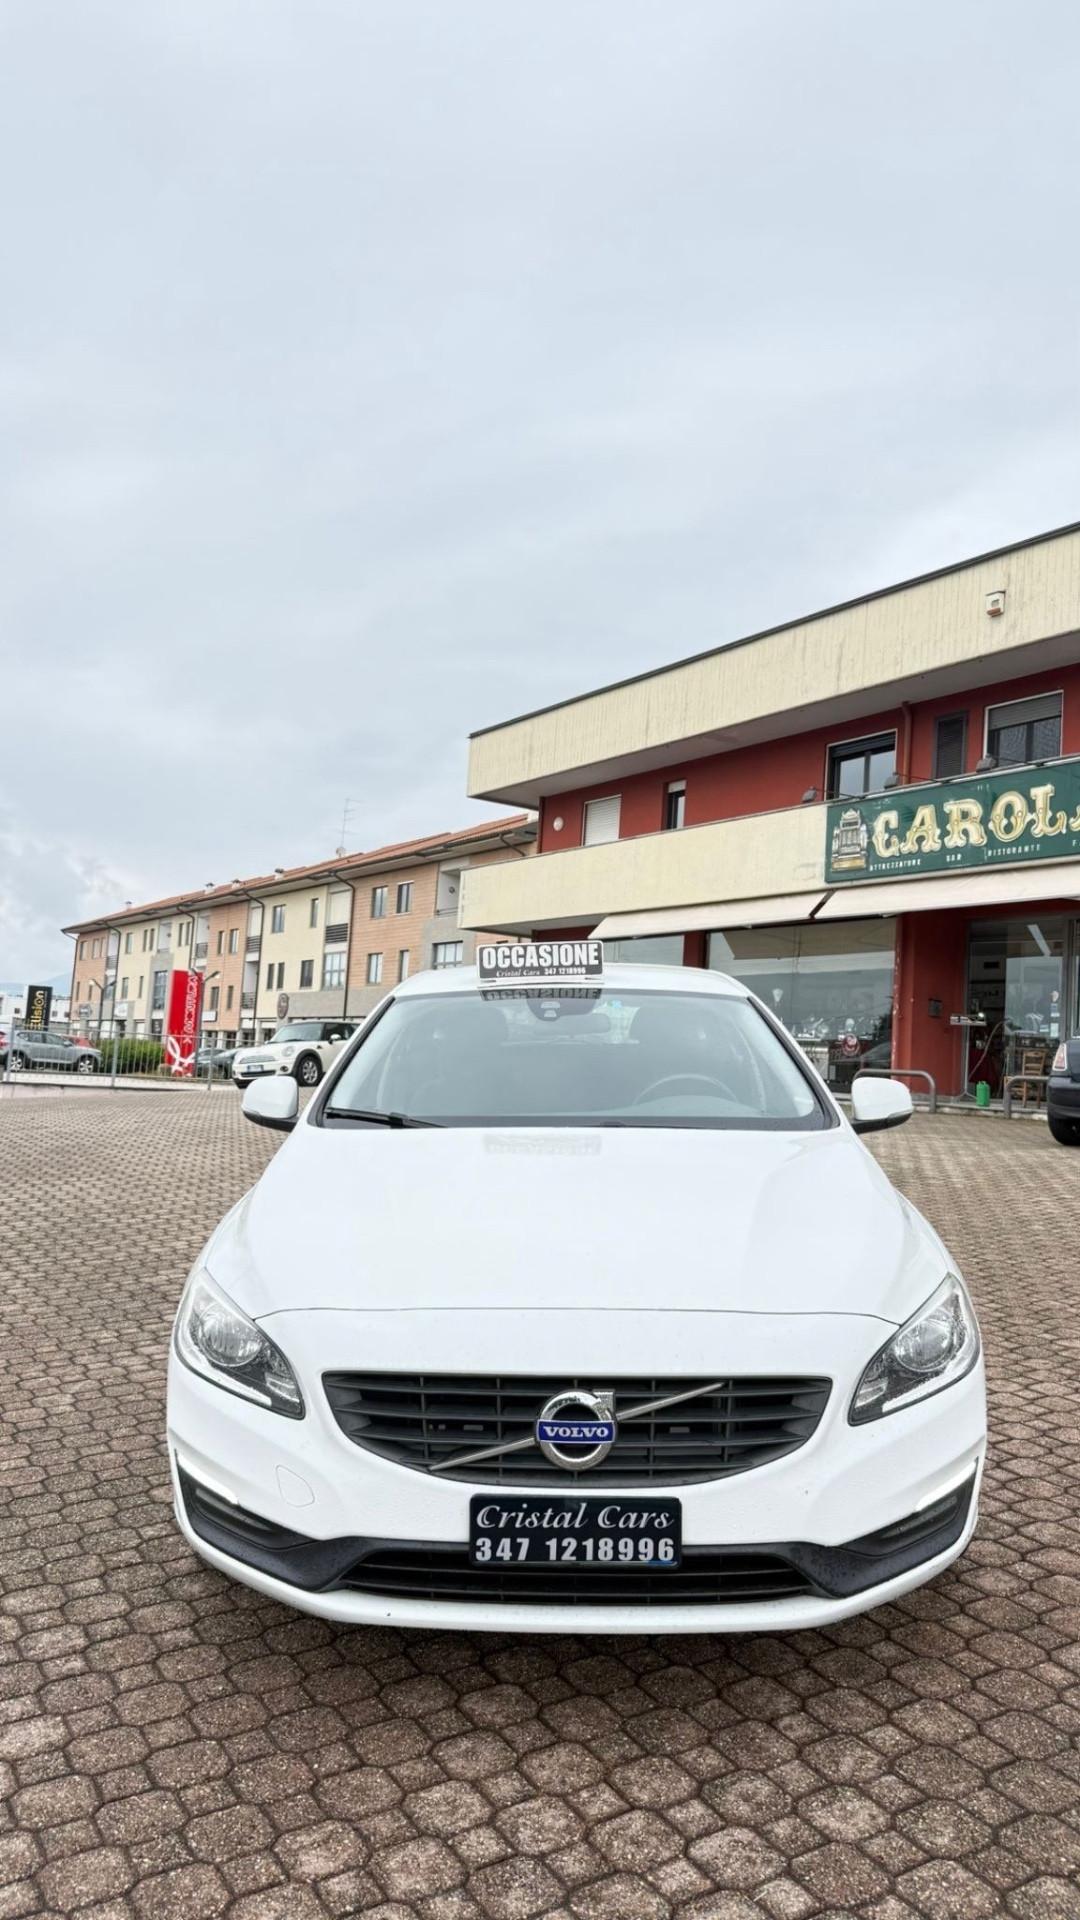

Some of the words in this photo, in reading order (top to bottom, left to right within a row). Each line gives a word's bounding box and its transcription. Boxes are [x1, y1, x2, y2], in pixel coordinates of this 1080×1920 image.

[873, 783, 1080, 858] CAROL
[946, 853, 962, 862] BAR
[988, 844, 1040, 857] RISTORANTE
[482, 943, 599, 969] OCCASIONE
[496, 969, 522, 978] Cristal
[523, 968, 540, 976] Cars
[544, 967, 556, 975] 347
[559, 966, 586, 975] 1218996
[543, 1426, 609, 1437] VOLVO
[476, 1503, 588, 1529] Cristal
[597, 1505, 674, 1529] Cars
[475, 1537, 530, 1561] 347
[545, 1537, 674, 1561] 1218996
